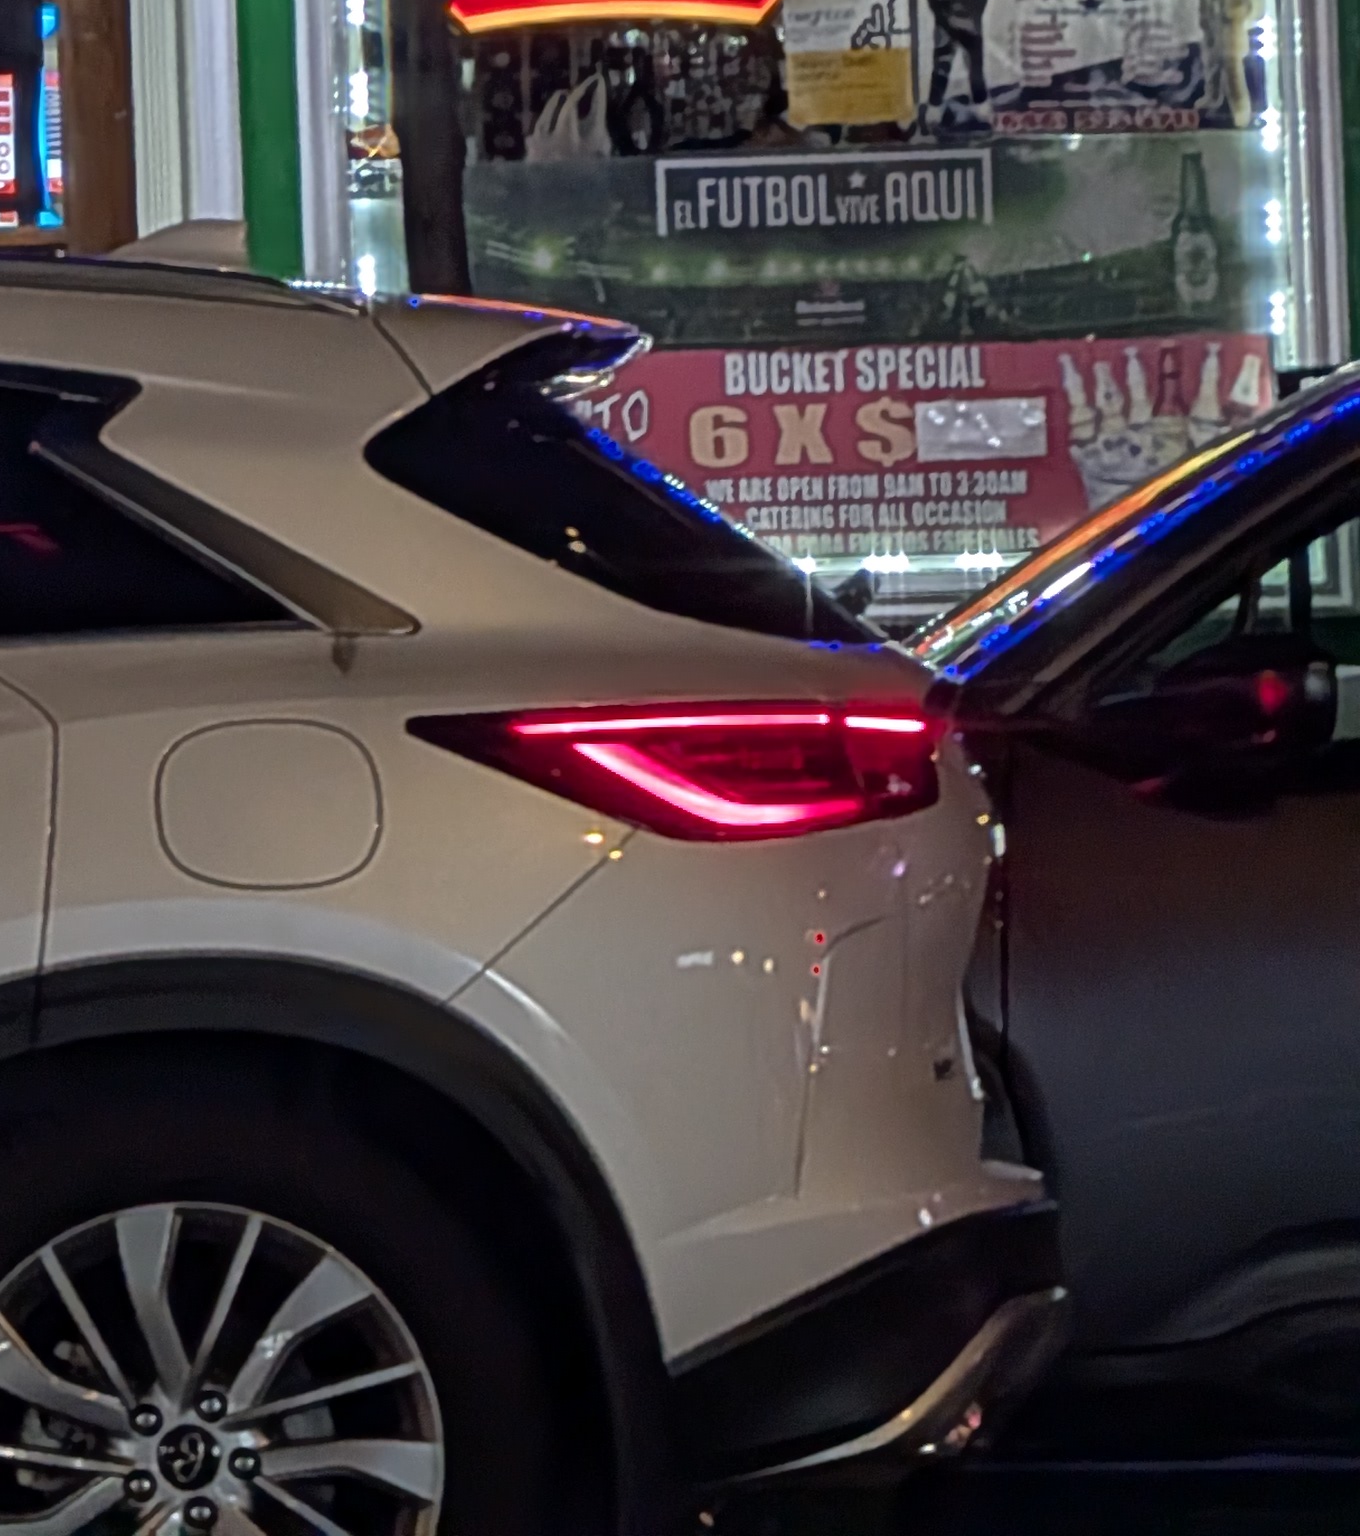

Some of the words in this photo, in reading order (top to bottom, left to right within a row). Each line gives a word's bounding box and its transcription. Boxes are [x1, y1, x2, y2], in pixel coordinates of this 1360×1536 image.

[696, 173, 836, 229] FUTBOL
[836, 193, 881, 225] VIVE
[885, 167, 977, 224] AQUI
[724, 349, 851, 396] BUCKET
[855, 345, 986, 391] SPECIAL
[689, 405, 751, 468] 6
[772, 403, 834, 465] X
[706, 478, 734, 503] WE
[738, 477, 773, 502] ARE
[777, 475, 824, 501] OPEN
[828, 473, 879, 500] FROM
[927, 471, 953, 497] TO
[839, 503, 875, 529] FOR
[877, 501, 908, 528] ALL
[911, 499, 1008, 526] OCCASION
